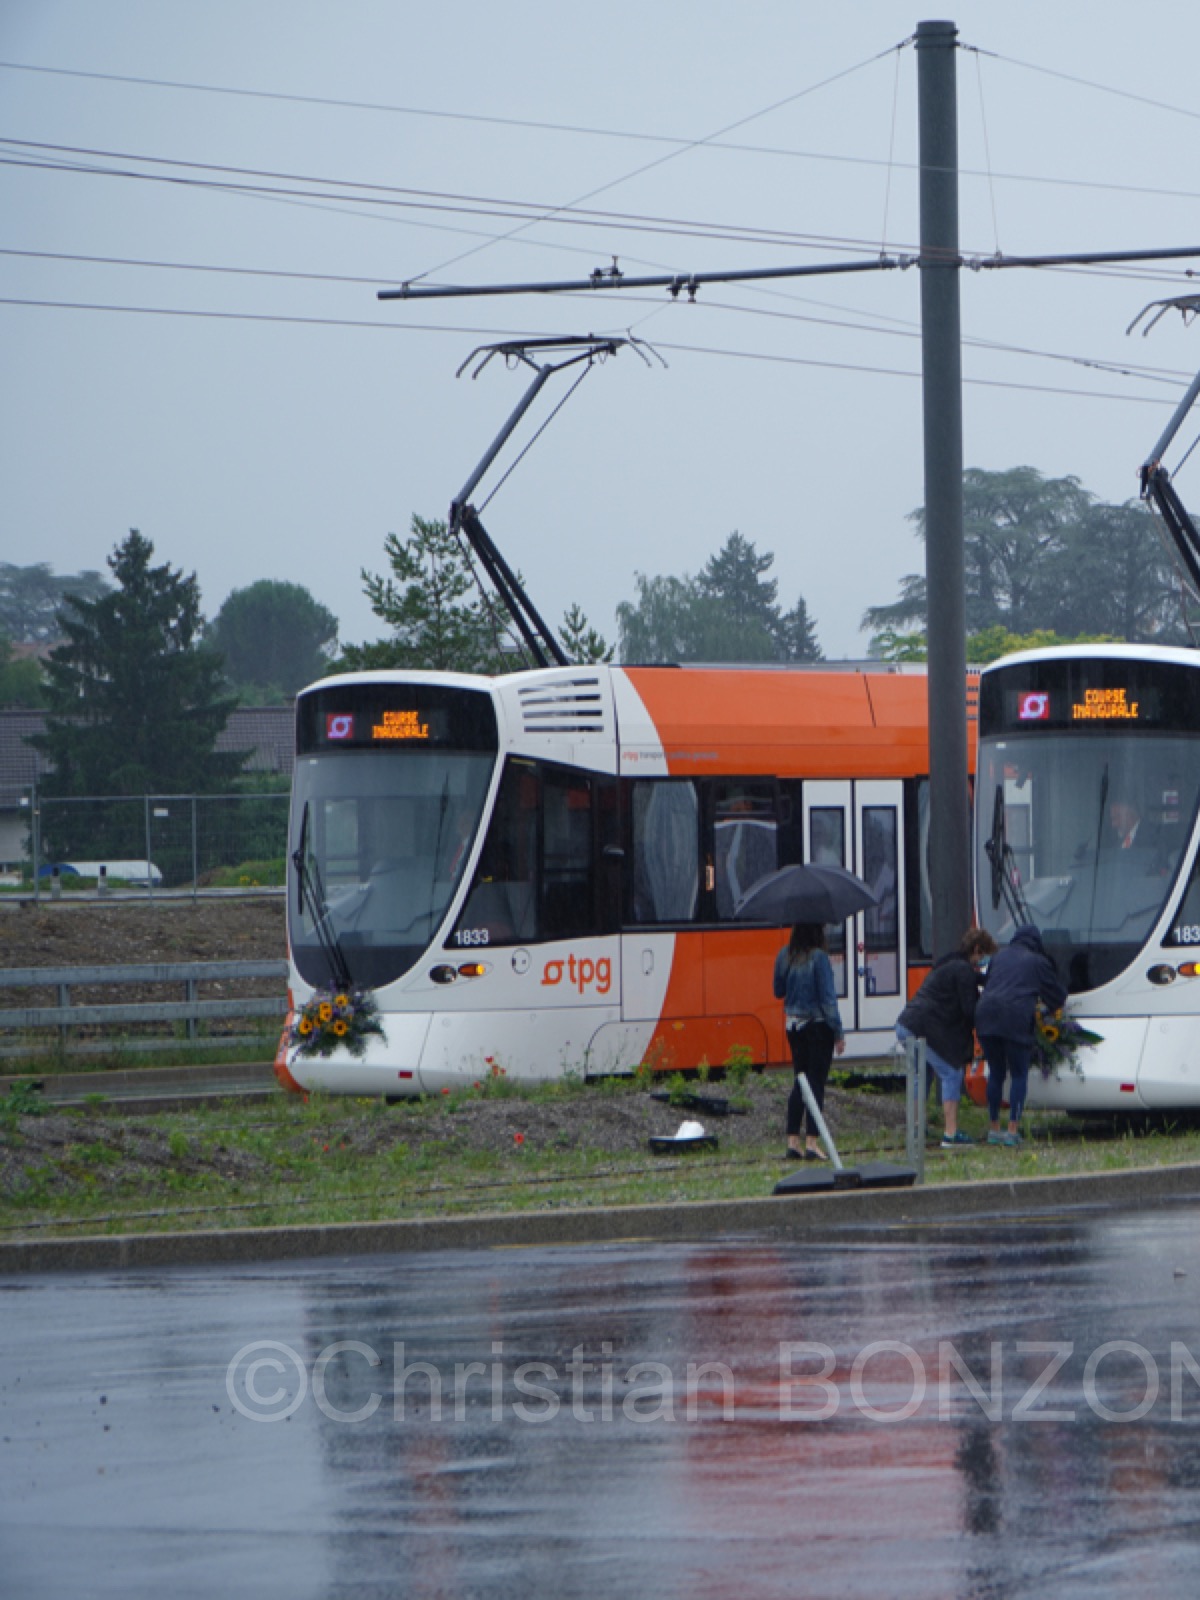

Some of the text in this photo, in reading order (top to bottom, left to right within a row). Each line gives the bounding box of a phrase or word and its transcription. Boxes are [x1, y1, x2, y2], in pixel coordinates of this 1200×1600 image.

[1085, 689, 1126, 702] COURSE
[1072, 702, 1138, 718] INAUGURALE
[455, 929, 489, 944] 1833
[568, 953, 611, 994] tpg
